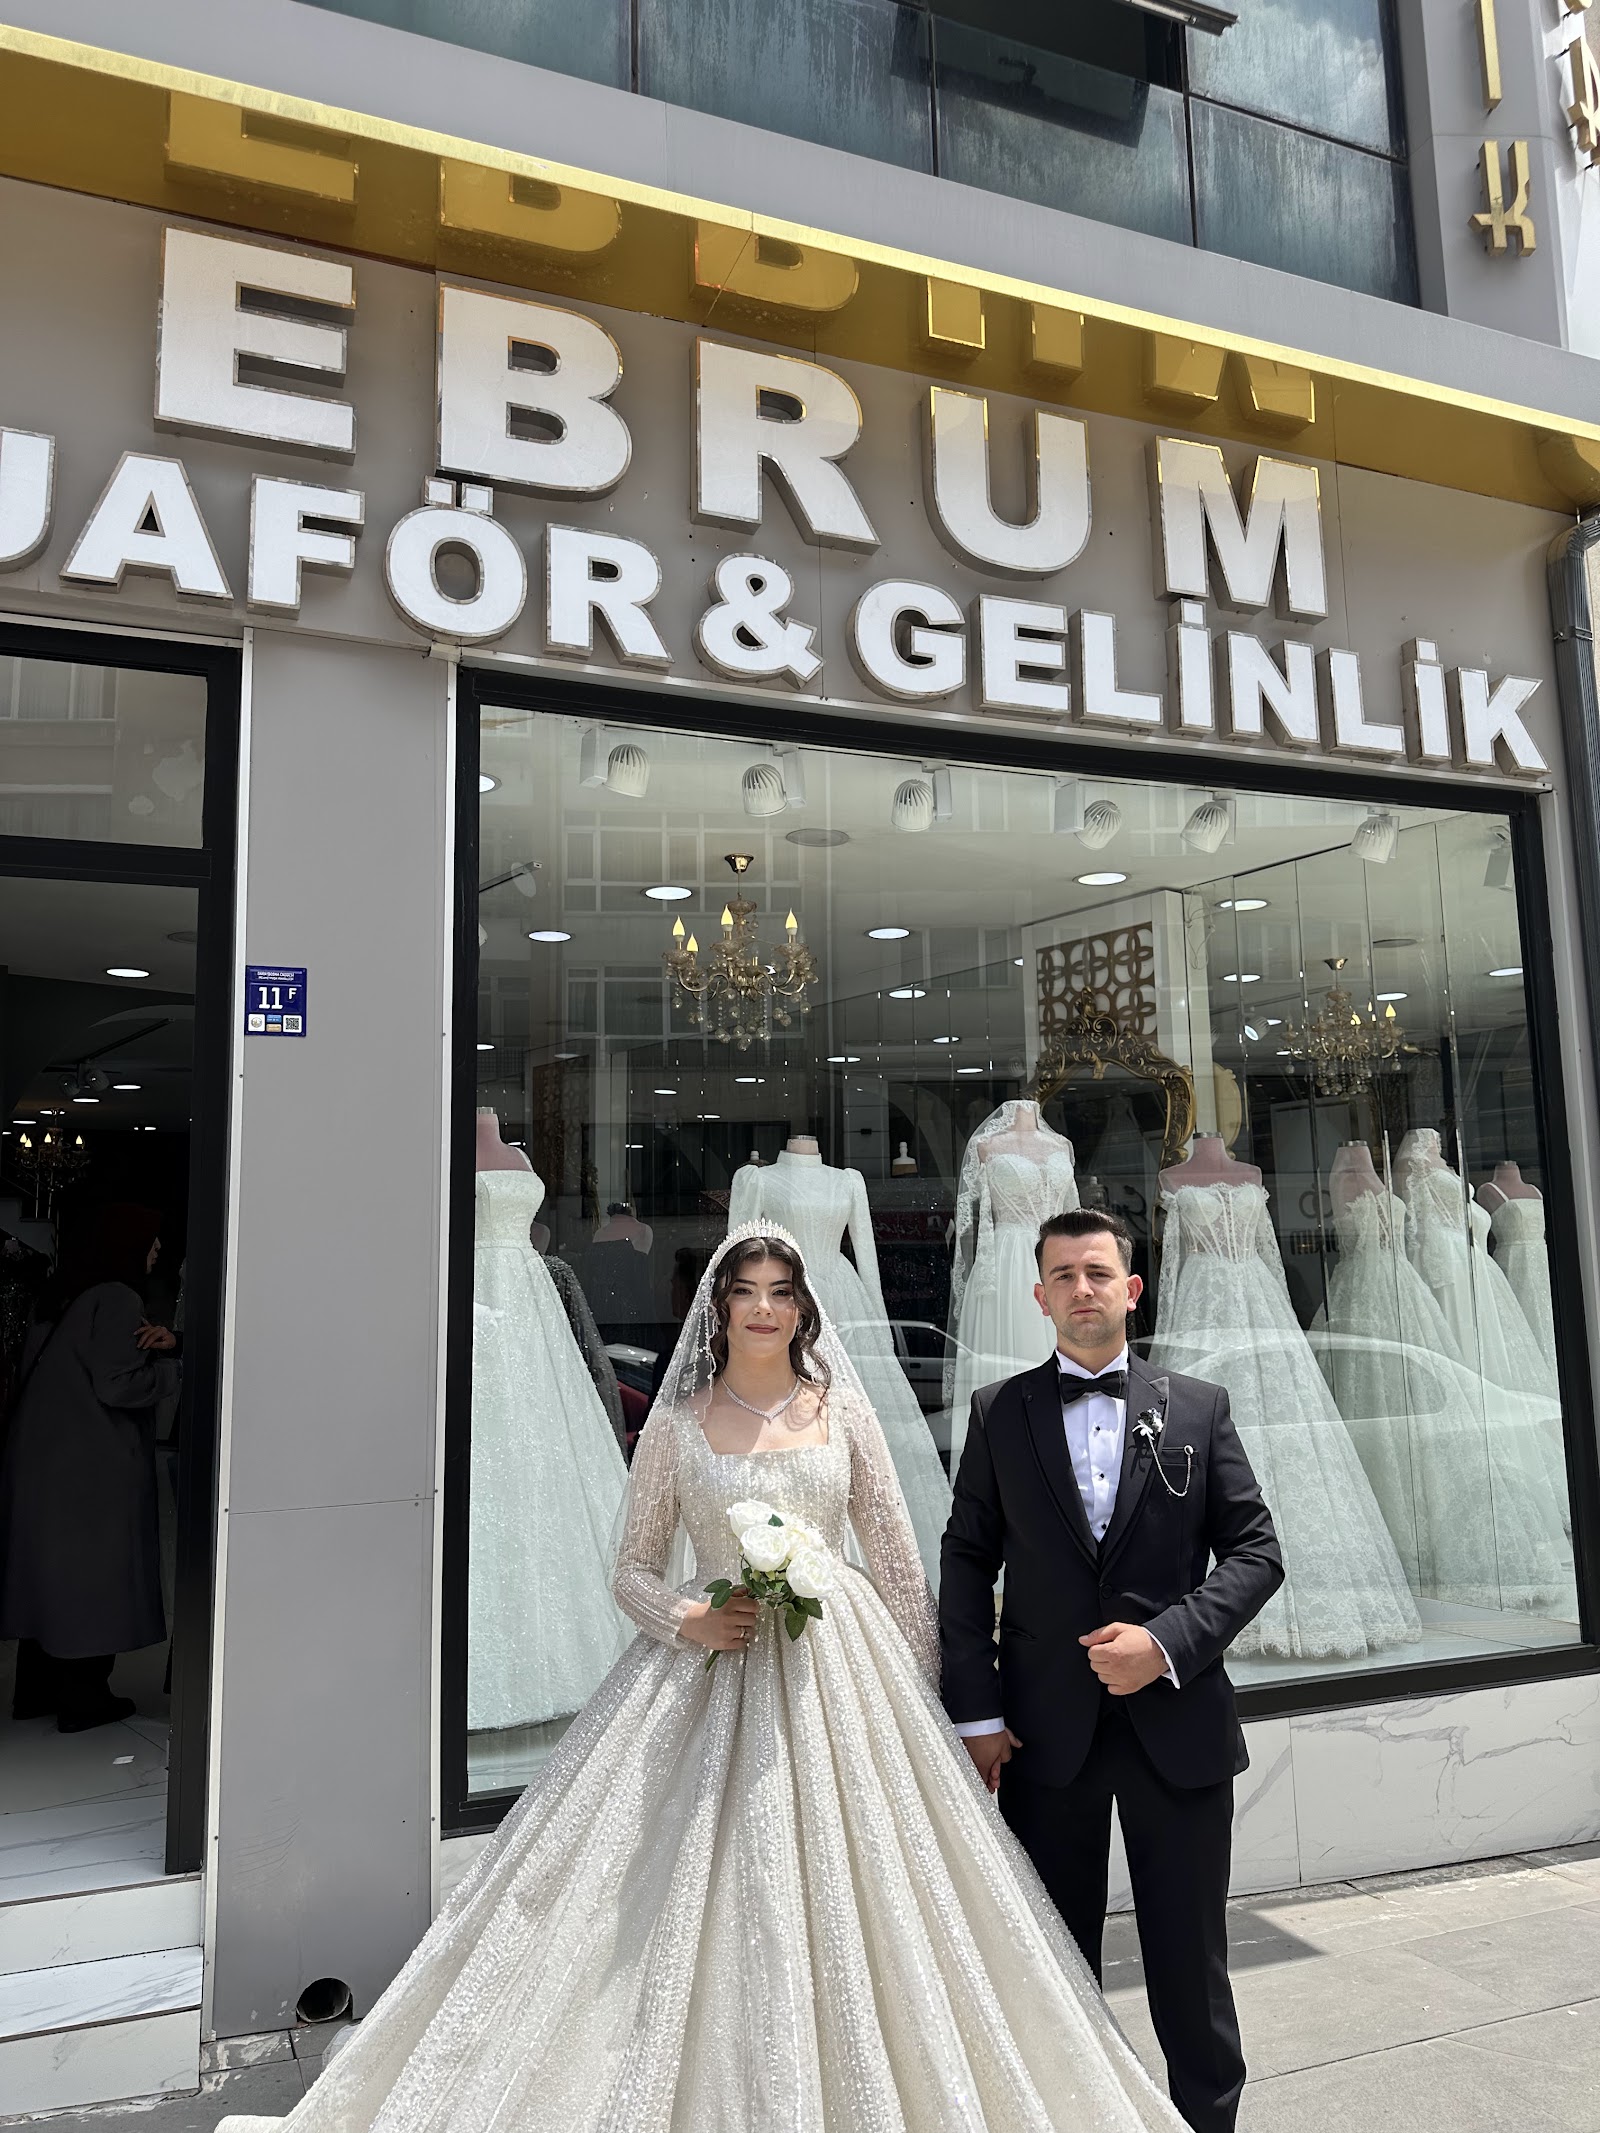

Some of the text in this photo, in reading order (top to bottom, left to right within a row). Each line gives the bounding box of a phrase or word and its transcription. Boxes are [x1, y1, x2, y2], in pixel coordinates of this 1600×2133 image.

[154, 223, 1328, 624] EBRUM
[693, 552, 826, 683] &
[846, 577, 1553, 778] GELİNLİK
[258, 987, 297, 1009] 11 F
